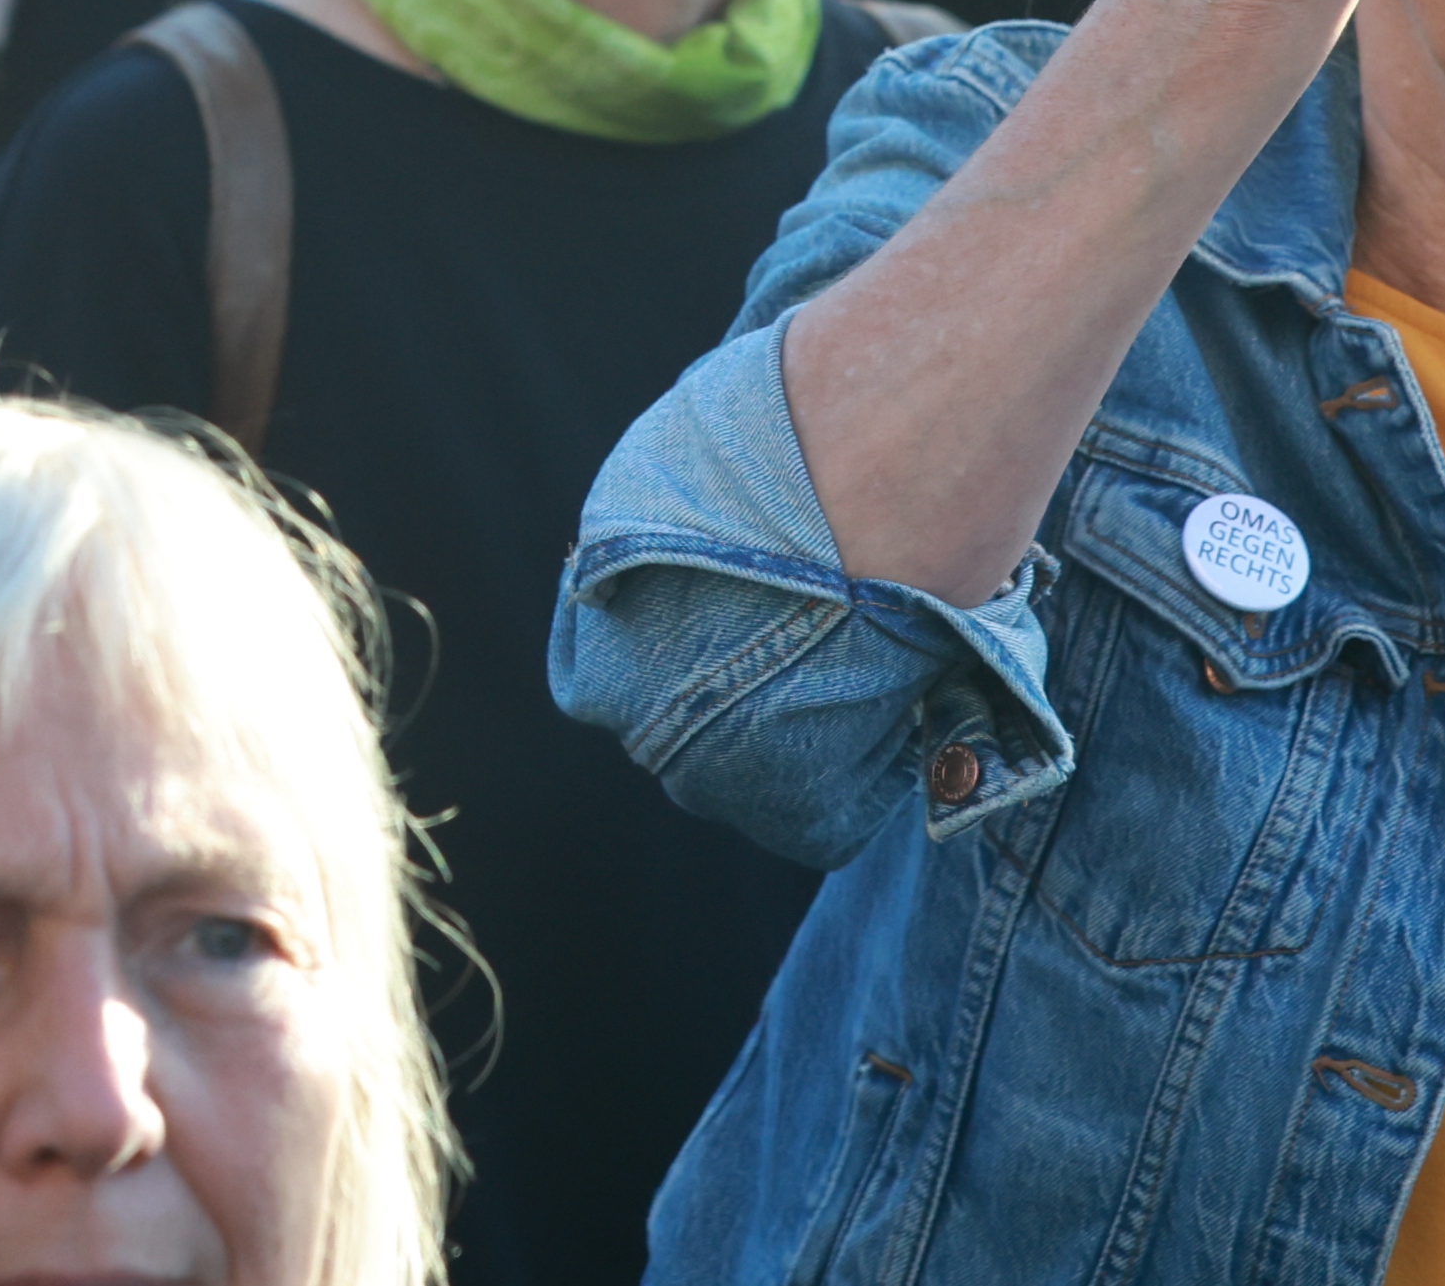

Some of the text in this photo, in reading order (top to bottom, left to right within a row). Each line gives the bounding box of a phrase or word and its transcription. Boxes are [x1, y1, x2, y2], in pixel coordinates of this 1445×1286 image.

[1209, 520, 1296, 570] GEGEN
[1220, 500, 1296, 545] OMAS
[1197, 539, 1294, 596] RECHTS
